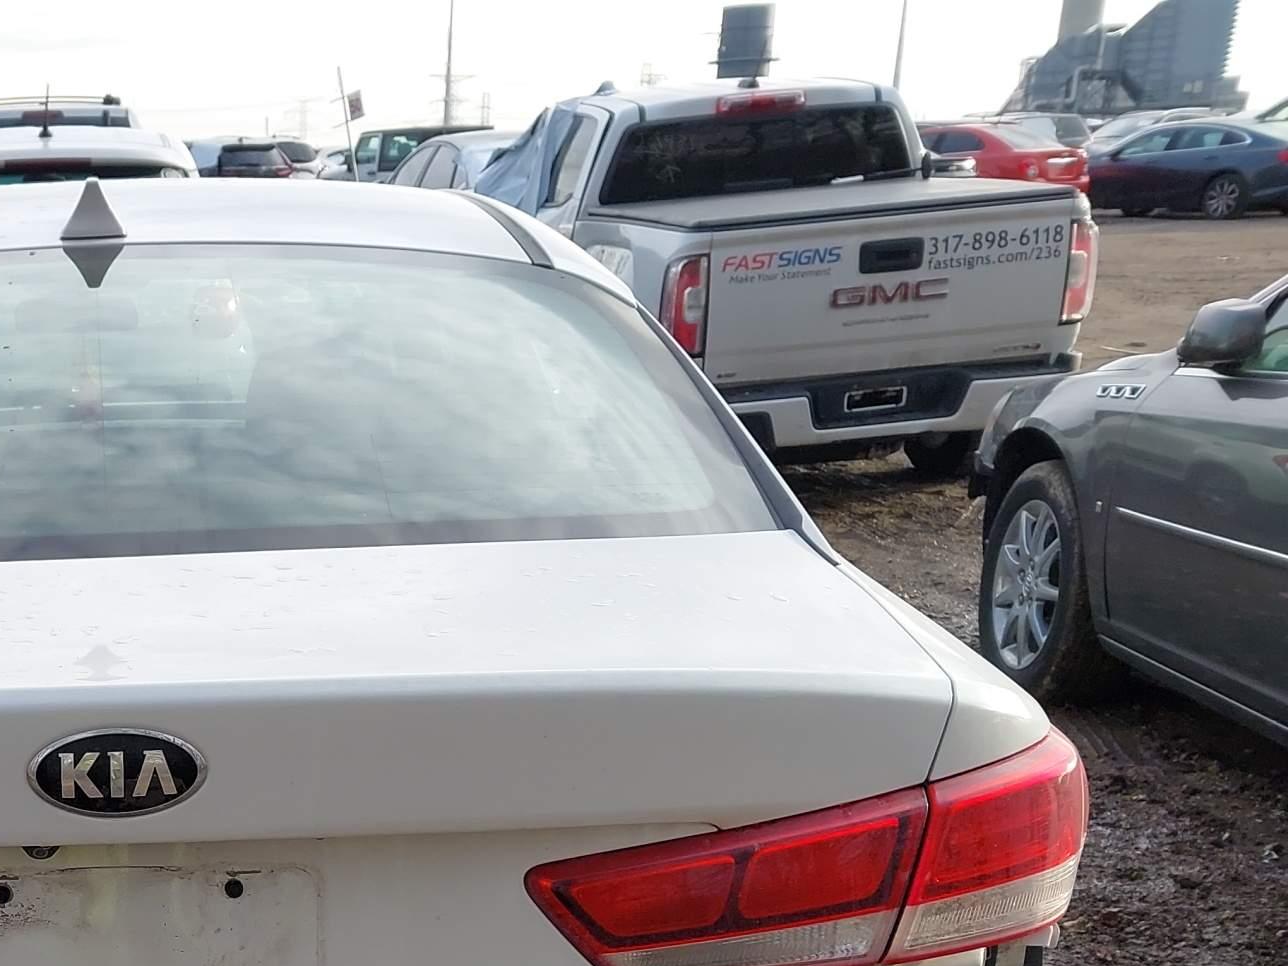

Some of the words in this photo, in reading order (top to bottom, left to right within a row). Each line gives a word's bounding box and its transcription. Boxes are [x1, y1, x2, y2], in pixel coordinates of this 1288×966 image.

[928, 225, 1064, 255] 317-898-6118
[722, 246, 844, 272] FASTSIGNS
[927, 246, 1062, 270] fastsigns.com/236
[728, 274, 755, 284] Make
[757, 272, 779, 282] Your
[781, 267, 832, 280] Statement
[829, 277, 950, 308] GMC
[58, 750, 178, 799] KIA
